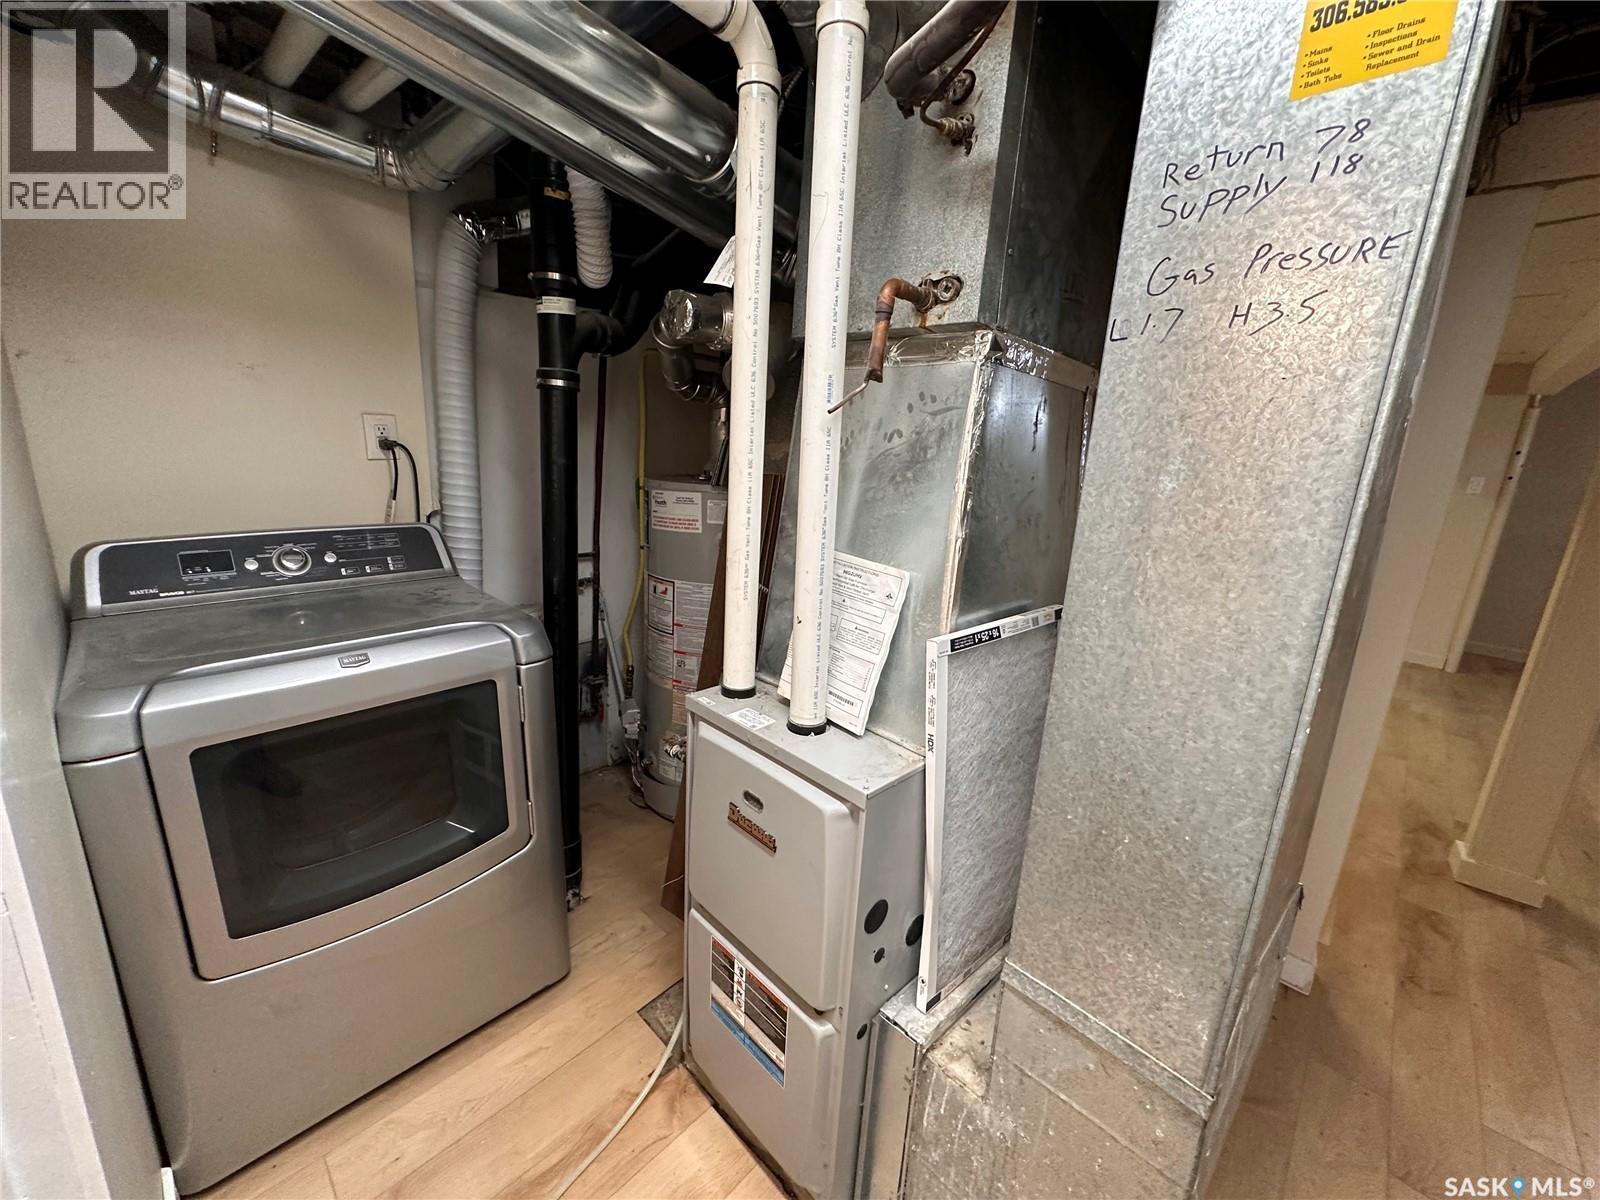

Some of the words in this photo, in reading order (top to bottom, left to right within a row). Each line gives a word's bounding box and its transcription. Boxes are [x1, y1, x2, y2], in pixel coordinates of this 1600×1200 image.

[1372, 26, 1394, 38] Floor
[1397, 17, 1426, 31] Drains
[1368, 48, 1394, 60] Sewer
[1397, 41, 1413, 52] and
[1416, 34, 1441, 47] Drain
[1370, 30, 1418, 49] Inspections
[1309, 46, 1333, 57] Mains
[1366, 51, 1419, 71] Replacement
[1306, 66, 1330, 78] Toilets
[1307, 57, 1329, 68] Sinks
[1303, 79, 1320, 89] Bath
[1324, 73, 1342, 83] Tubs
[1162, 141, 1285, 189] Return
[1315, 118, 1372, 154] 78
[1157, 173, 1288, 228] Supply
[1146, 256, 1216, 297] Gas
